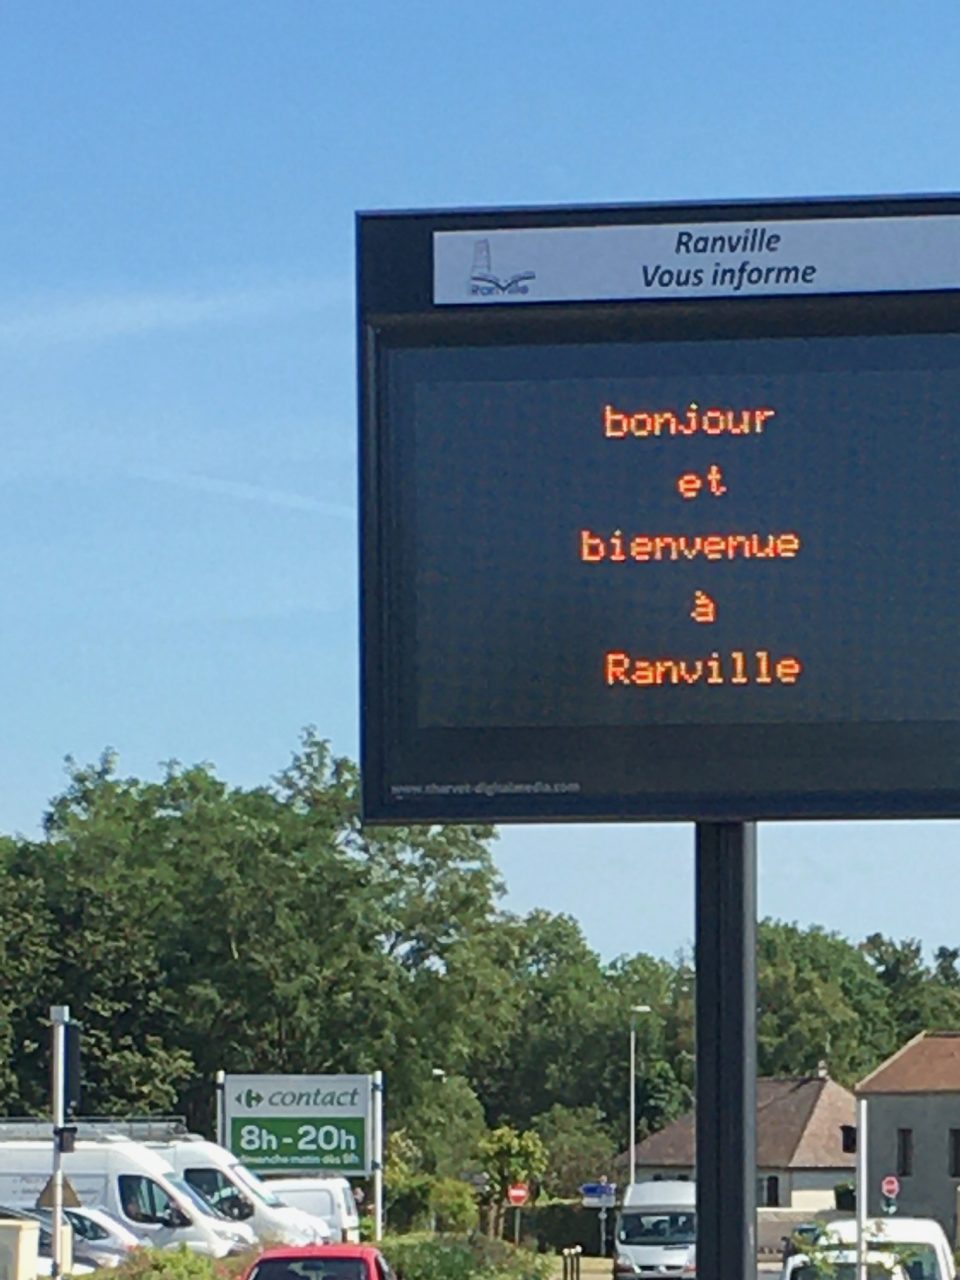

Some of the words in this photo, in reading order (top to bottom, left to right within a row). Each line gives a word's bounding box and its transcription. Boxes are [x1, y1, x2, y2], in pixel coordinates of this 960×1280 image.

[674, 228, 782, 255] Ranville
[641, 264, 704, 288] Vous
[711, 261, 818, 291] informe
[604, 402, 776, 438] bonjour
[677, 463, 729, 499] et
[580, 528, 801, 562] bienvenue
[689, 589, 716, 623] à
[604, 650, 802, 686] Ranville
[268, 1087, 360, 1107] contact
